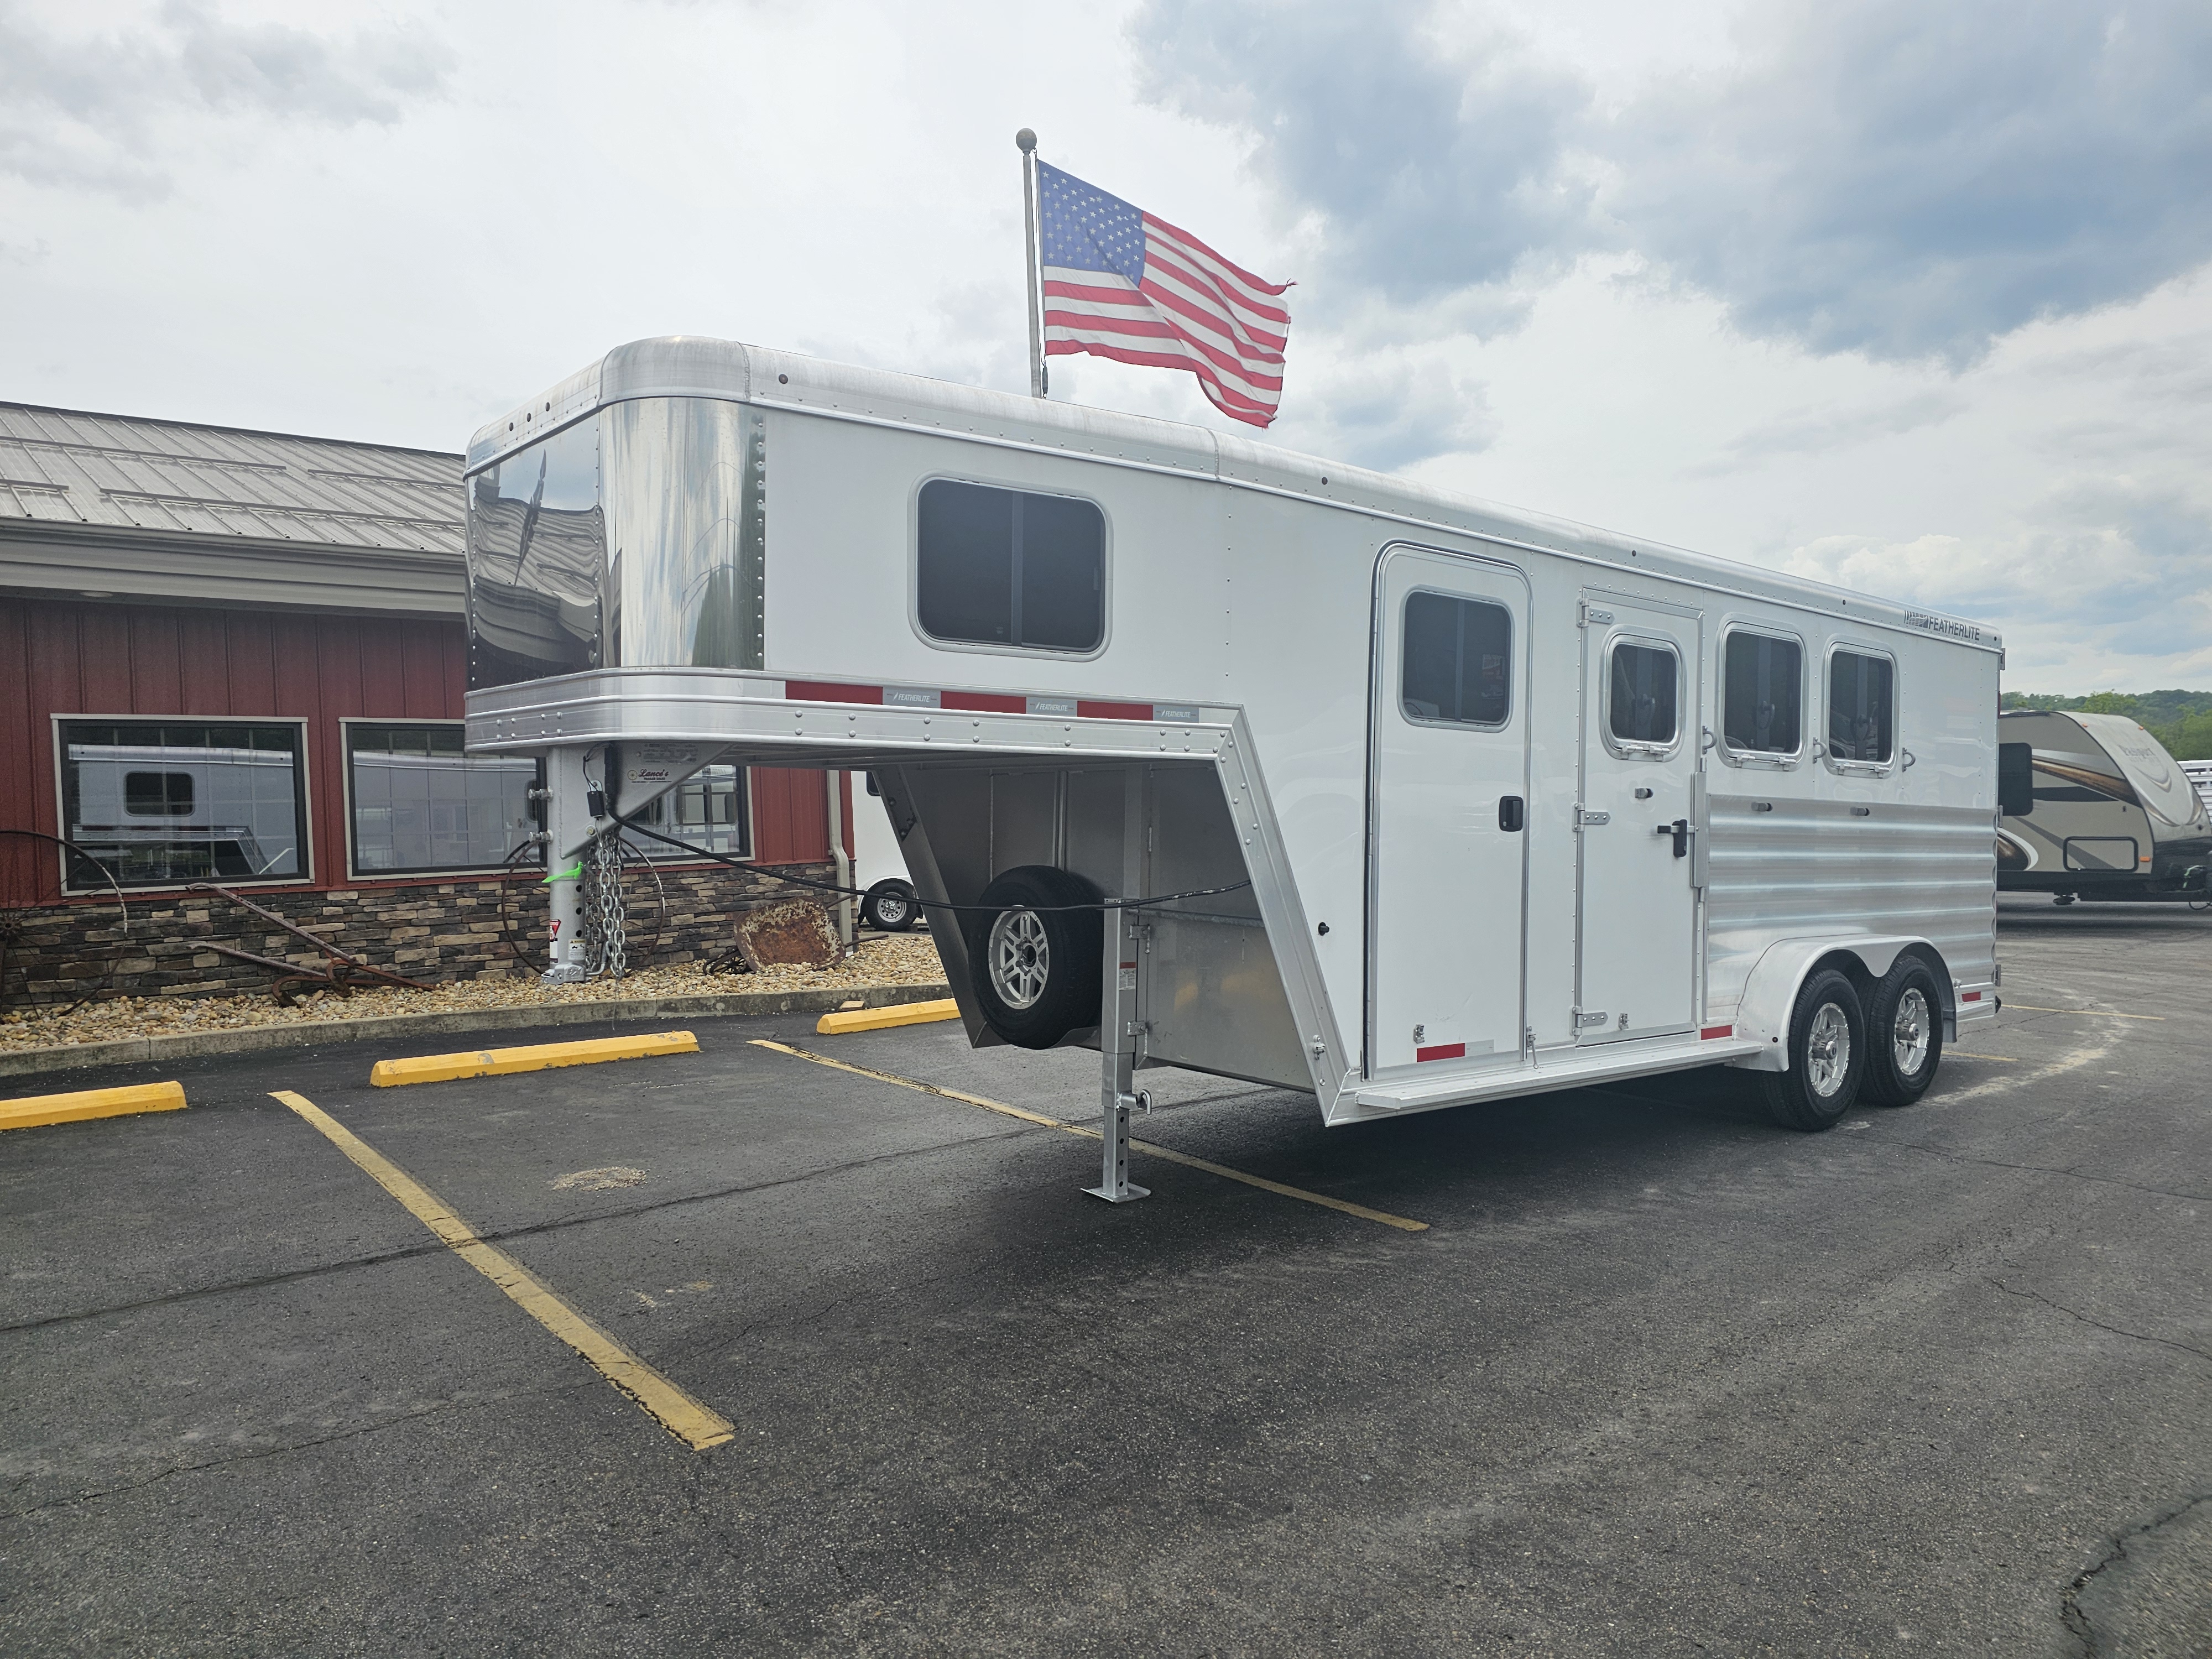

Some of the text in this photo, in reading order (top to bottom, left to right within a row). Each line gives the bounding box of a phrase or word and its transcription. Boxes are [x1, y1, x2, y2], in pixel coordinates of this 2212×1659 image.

[1928, 616, 1980, 640] FEATHERLITE
[898, 693, 930, 702] FEATHERLITE
[1040, 703, 1068, 712] FEATHERLITE
[638, 769, 669, 777] Lance's
